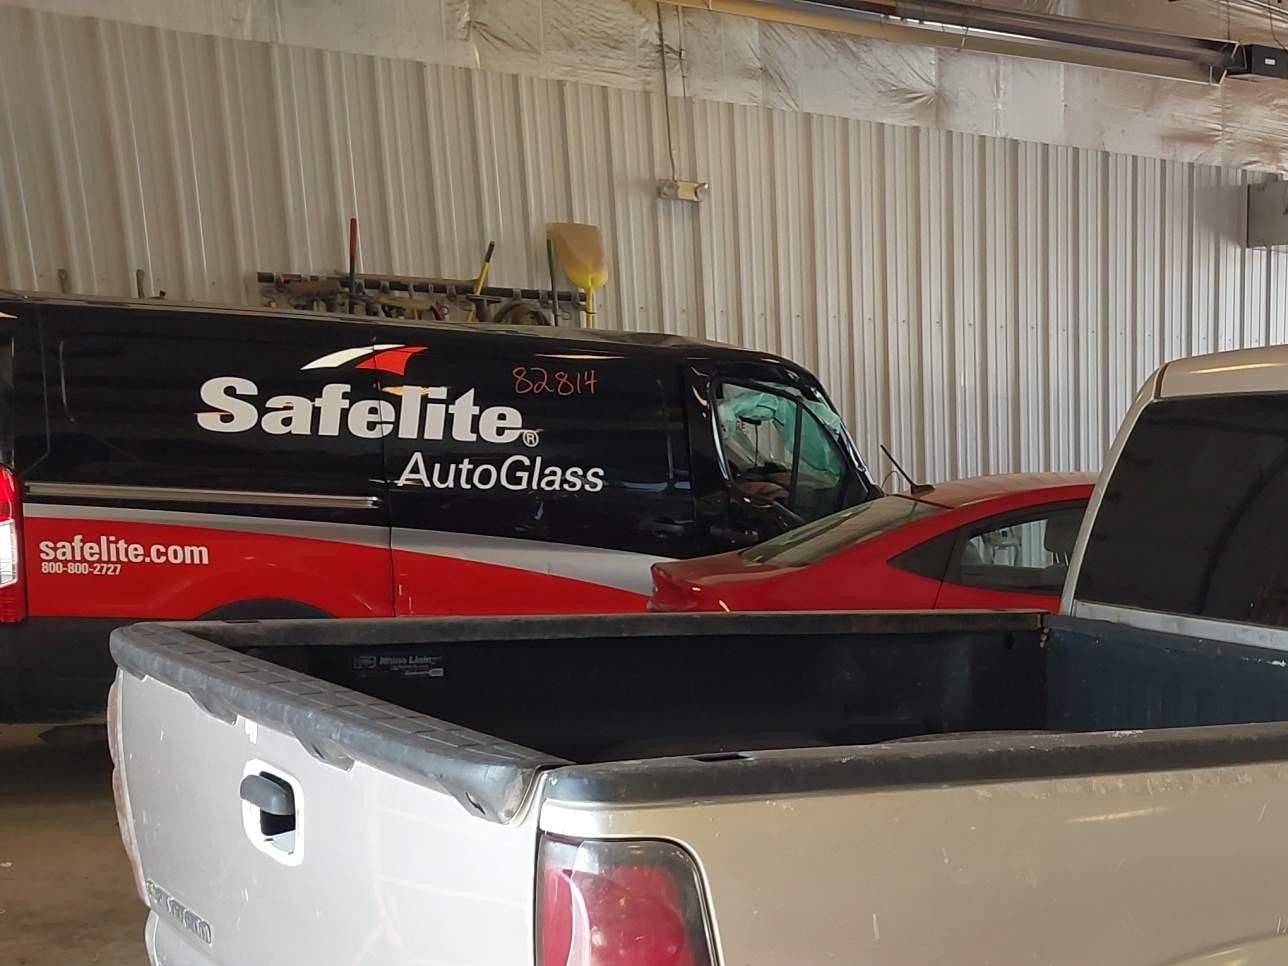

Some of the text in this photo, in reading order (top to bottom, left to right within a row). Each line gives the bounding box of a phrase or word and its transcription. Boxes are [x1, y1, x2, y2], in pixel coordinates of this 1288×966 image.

[512, 366, 599, 396] 82814
[396, 451, 605, 492] AutoGlass
[39, 534, 209, 565] safelite.com
[41, 561, 121, 576] 800-800-2727
